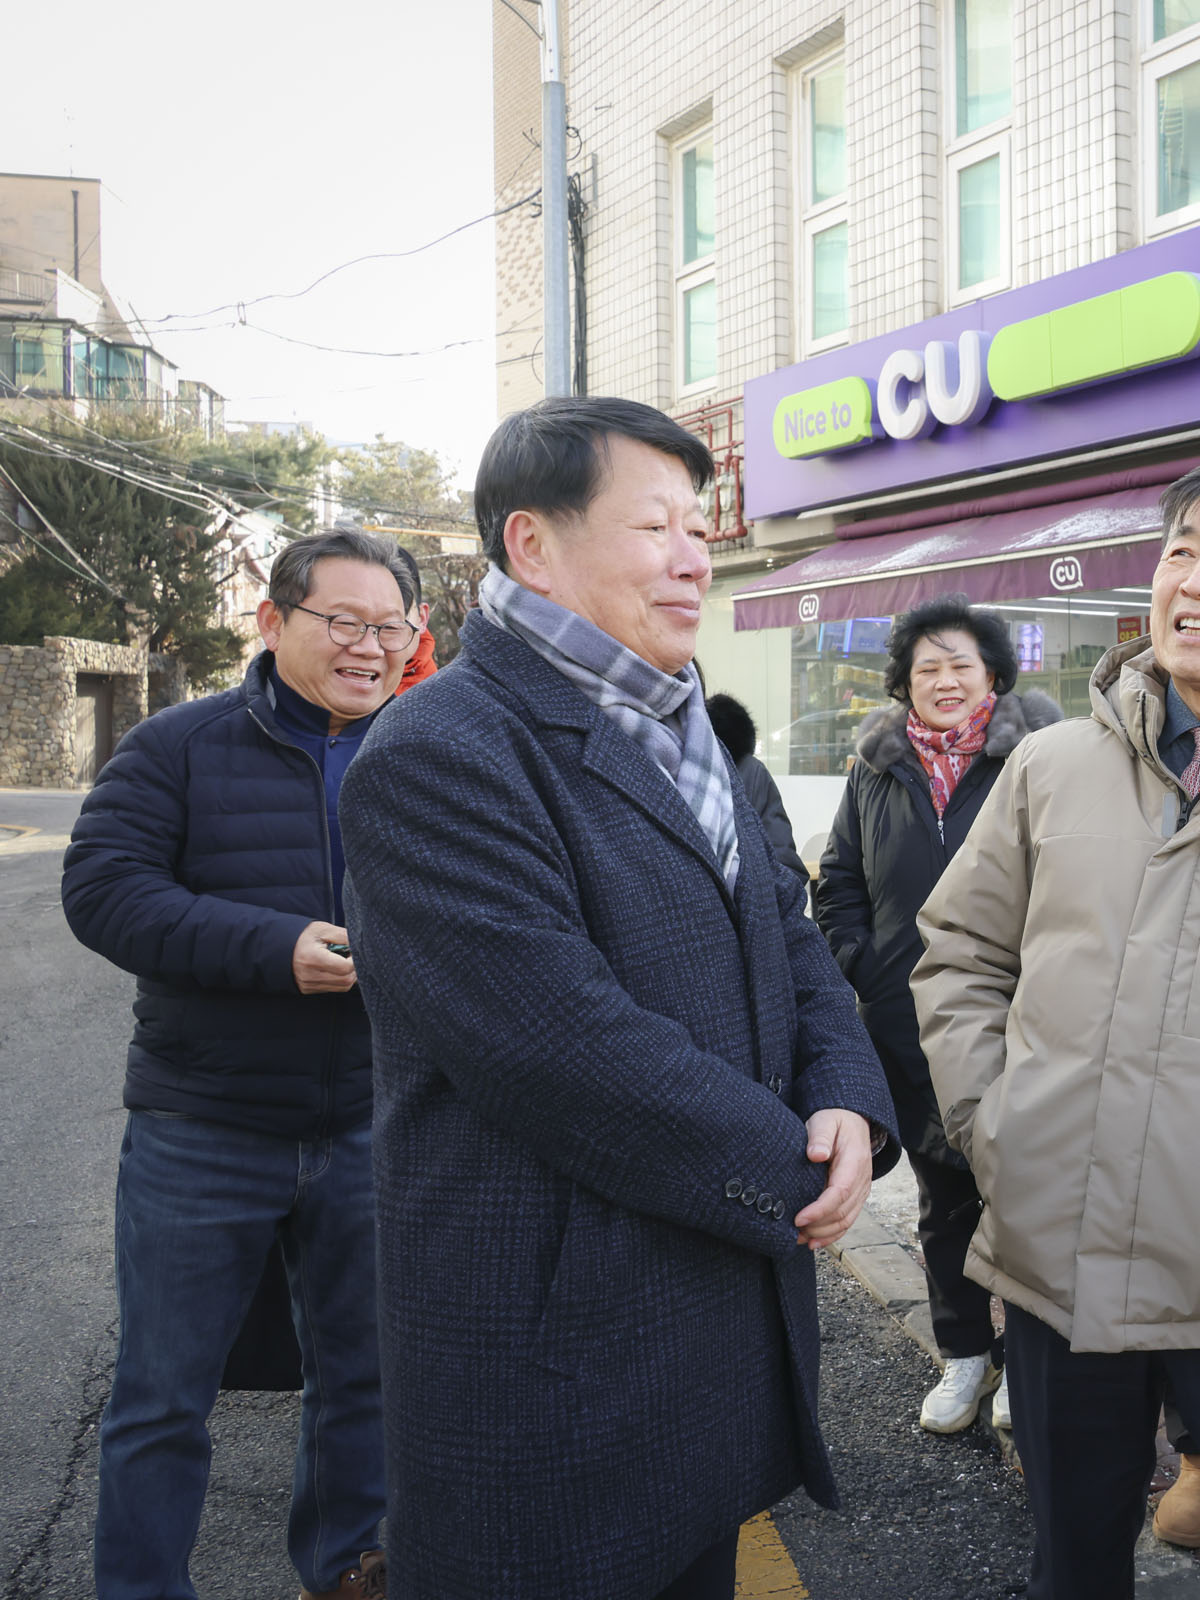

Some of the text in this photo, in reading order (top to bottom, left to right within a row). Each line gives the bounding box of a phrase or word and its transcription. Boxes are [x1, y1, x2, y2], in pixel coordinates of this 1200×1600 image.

[784, 330, 981, 443] Nice to CU
[1055, 564, 1075, 582] CU
